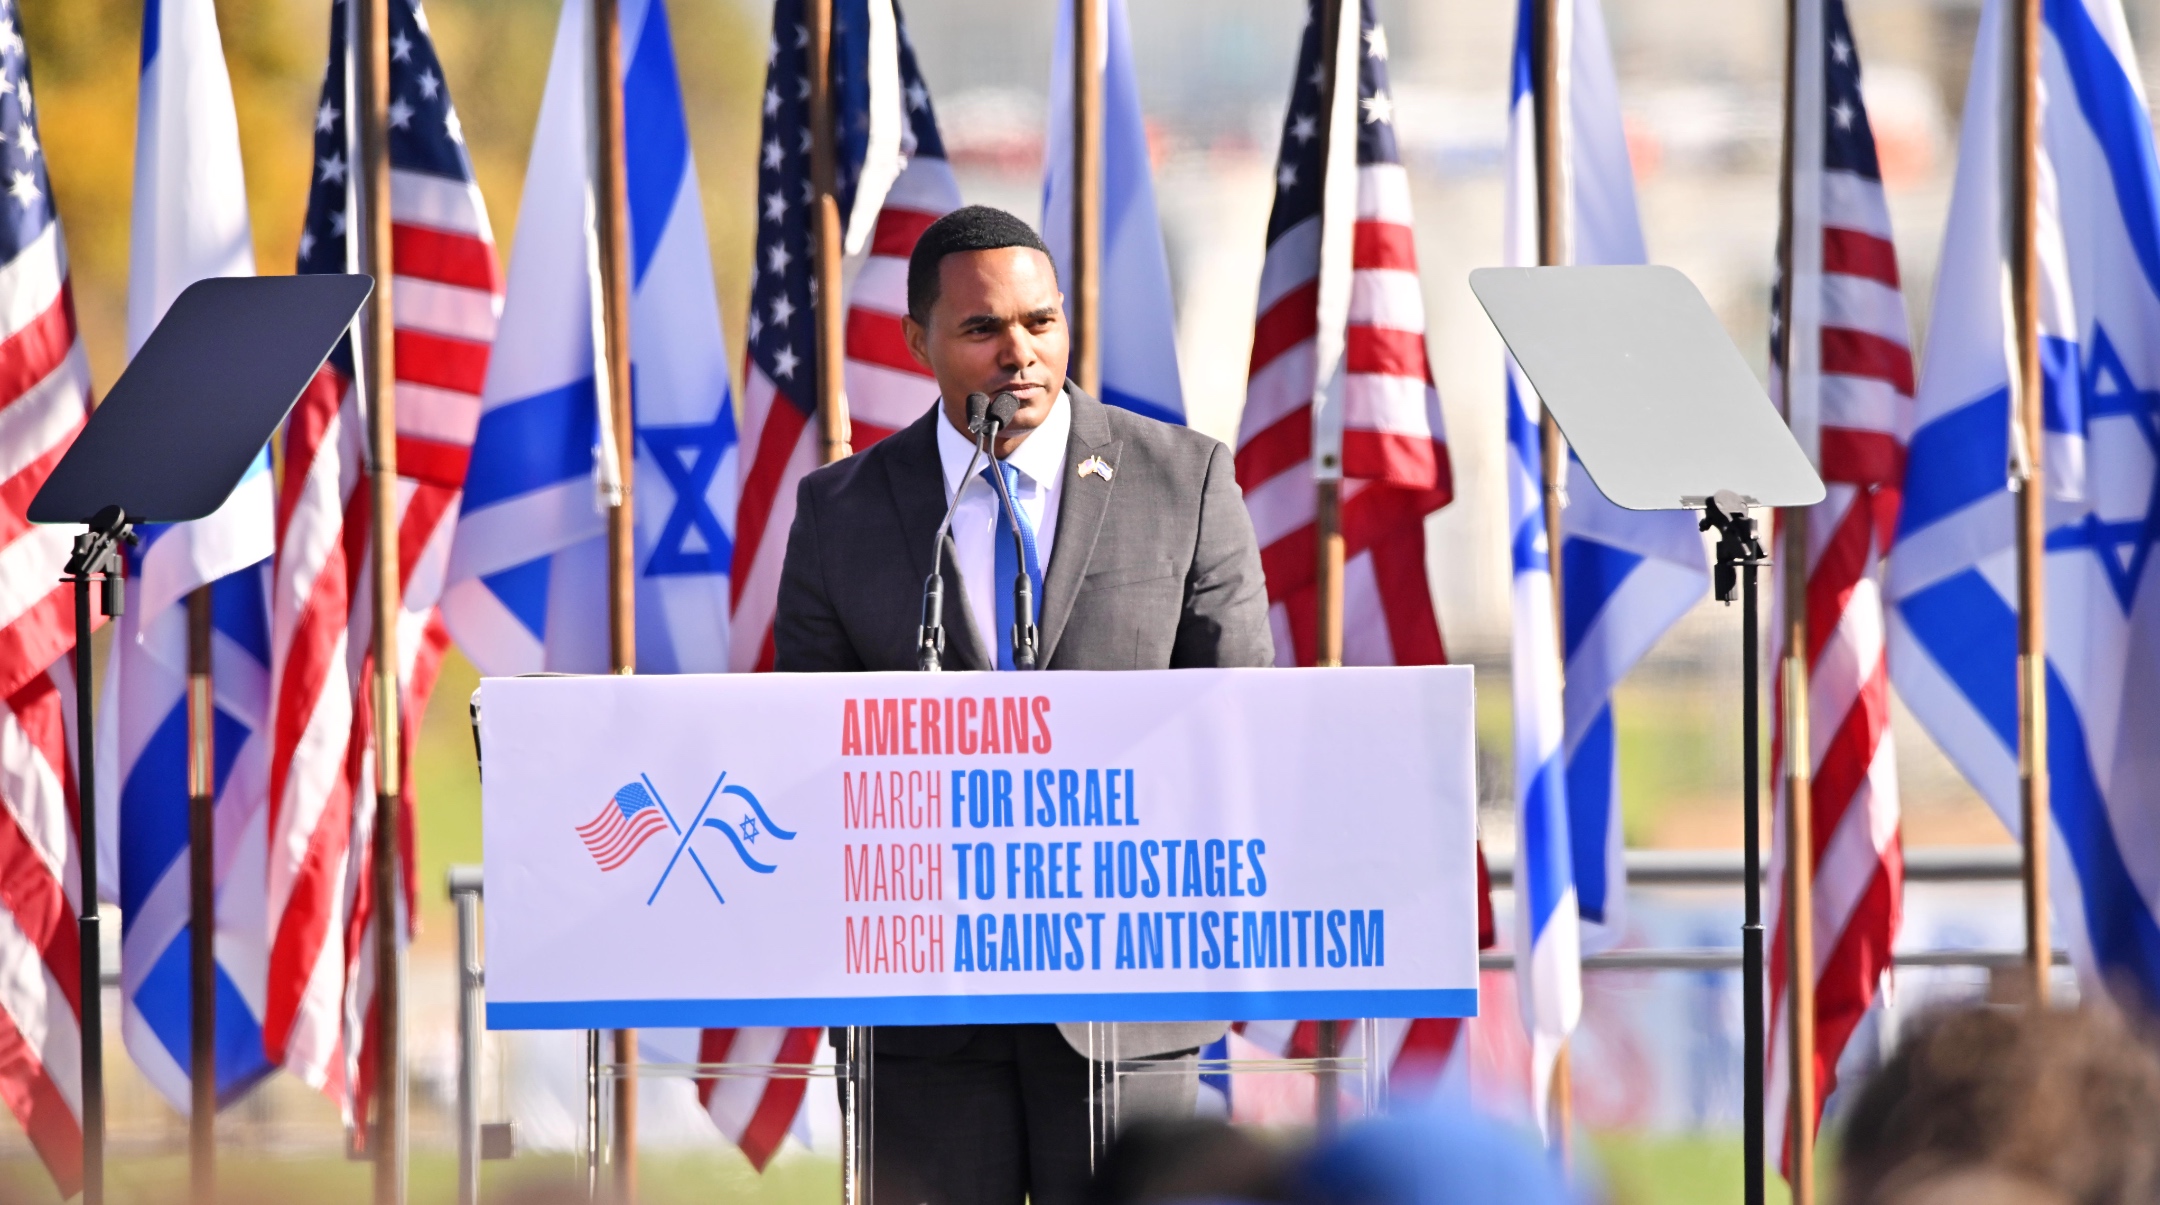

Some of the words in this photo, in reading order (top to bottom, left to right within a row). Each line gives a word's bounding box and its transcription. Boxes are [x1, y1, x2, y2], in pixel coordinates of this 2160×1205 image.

[842, 696, 1053, 756] AMERICANS
[843, 770, 941, 829] MARCH
[951, 769, 1014, 829] FOR
[1023, 768, 1140, 828] ISRAEL
[844, 843, 943, 902] MARCH
[951, 841, 996, 900] TO
[1006, 840, 1083, 899] FREE
[1093, 838, 1267, 899] HOSTAGES
[845, 914, 944, 974] MARCH
[953, 911, 1106, 973] AGAINST
[1115, 909, 1385, 970] ANTISEMITISM
